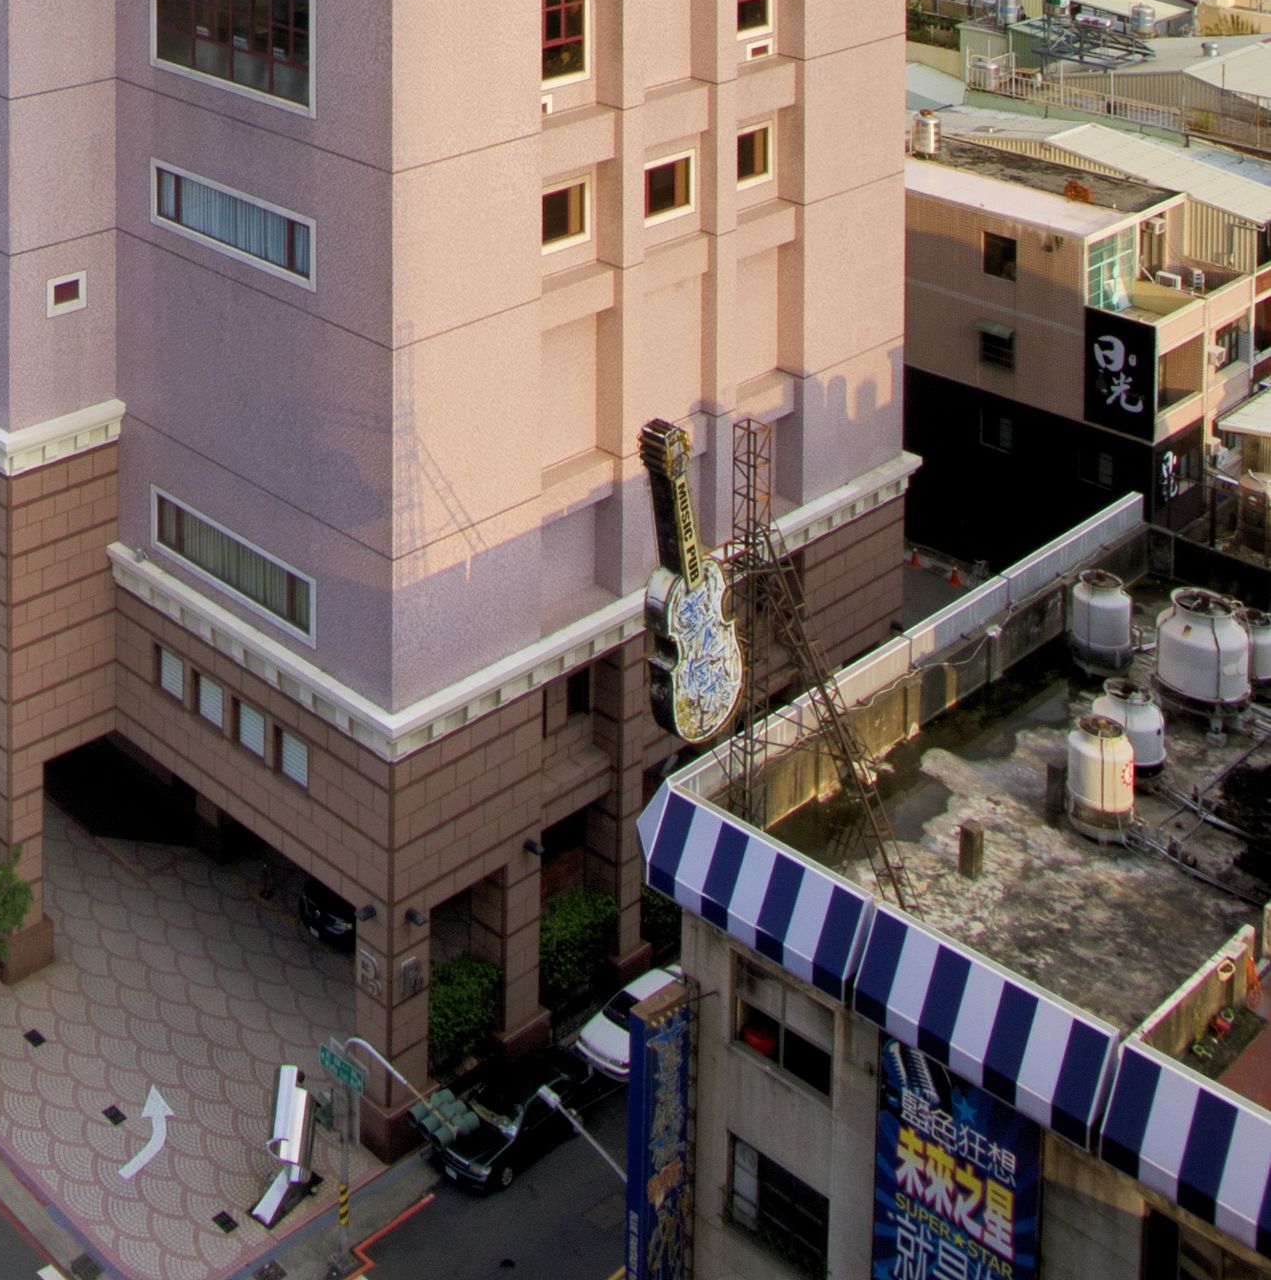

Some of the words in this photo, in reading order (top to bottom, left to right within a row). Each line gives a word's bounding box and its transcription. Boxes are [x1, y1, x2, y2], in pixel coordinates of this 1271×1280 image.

[677, 482, 695, 543] MUSIC
[686, 543, 699, 583] PUB
[900, 1089, 1017, 1188] 藍色狂想
[896, 1125, 1016, 1261] 未來之星
